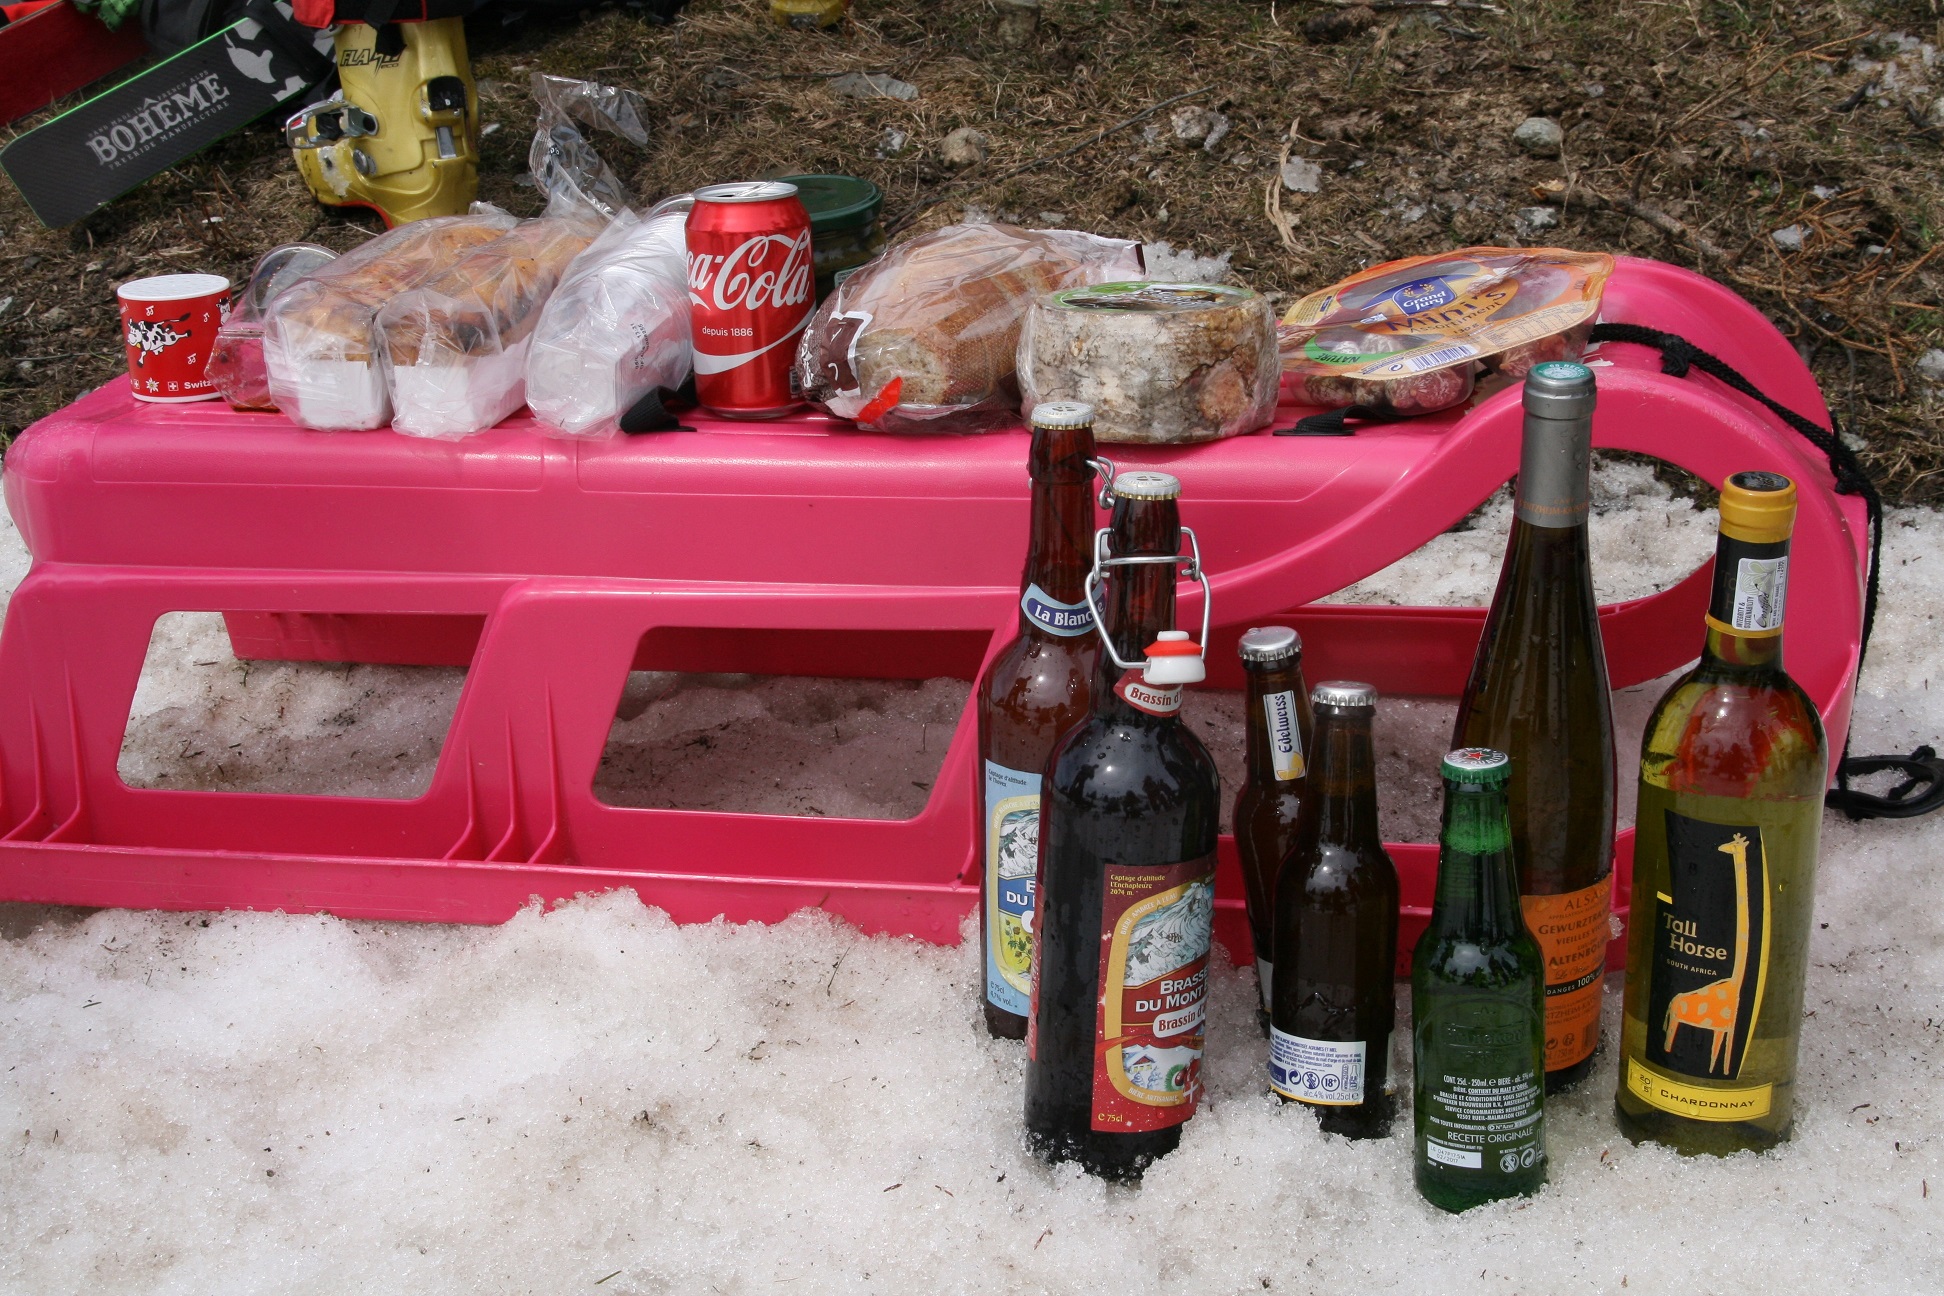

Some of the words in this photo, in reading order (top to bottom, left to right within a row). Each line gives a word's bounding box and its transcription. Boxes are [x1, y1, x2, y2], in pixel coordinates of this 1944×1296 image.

[157, 82, 188, 100] FRENCH
[190, 70, 209, 83] ALPS
[108, 142, 157, 170] FREERIDE
[160, 101, 230, 142] MANUFACTURE
[686, 227, 813, 312] ca-Cola
[1403, 290, 1446, 307] Grand
[1410, 302, 1503, 333] Assortiment
[702, 325, 729, 338] depuis
[730, 327, 753, 337] 1886
[1315, 352, 1361, 363] NATURE
[1034, 604, 1050, 623] La
[1744, 596, 1754, 629] SUSTAINABILITY
[1130, 686, 1172, 706] Brassin
[1275, 694, 1293, 753] Edelweiss
[1110, 874, 1136, 882] Captage
[1006, 891, 1028, 906] DU
[1663, 912, 1697, 938] Tall
[1556, 932, 1590, 945] VIEILLES
[1669, 934, 1728, 961] Horse
[1666, 958, 1688, 972] SOUTH
[1690, 966, 1717, 976] AFRICA
[1547, 985, 1575, 996] DANGES
[1577, 974, 1596, 988] 100%
[1135, 998, 1162, 1012] DU
[1166, 984, 1204, 1009] MONT
[1158, 1011, 1196, 1032] Brassin
[1503, 1093, 1514, 1101] SOUS
[1660, 1088, 1755, 1109] CHARDONNAY
[1107, 1113, 1123, 1123] 75cl
[1444, 1105, 1462, 1114] SERVICE
[1447, 1131, 1485, 1143] RECETTE
[1488, 1125, 1534, 1143] ORIGINALE
